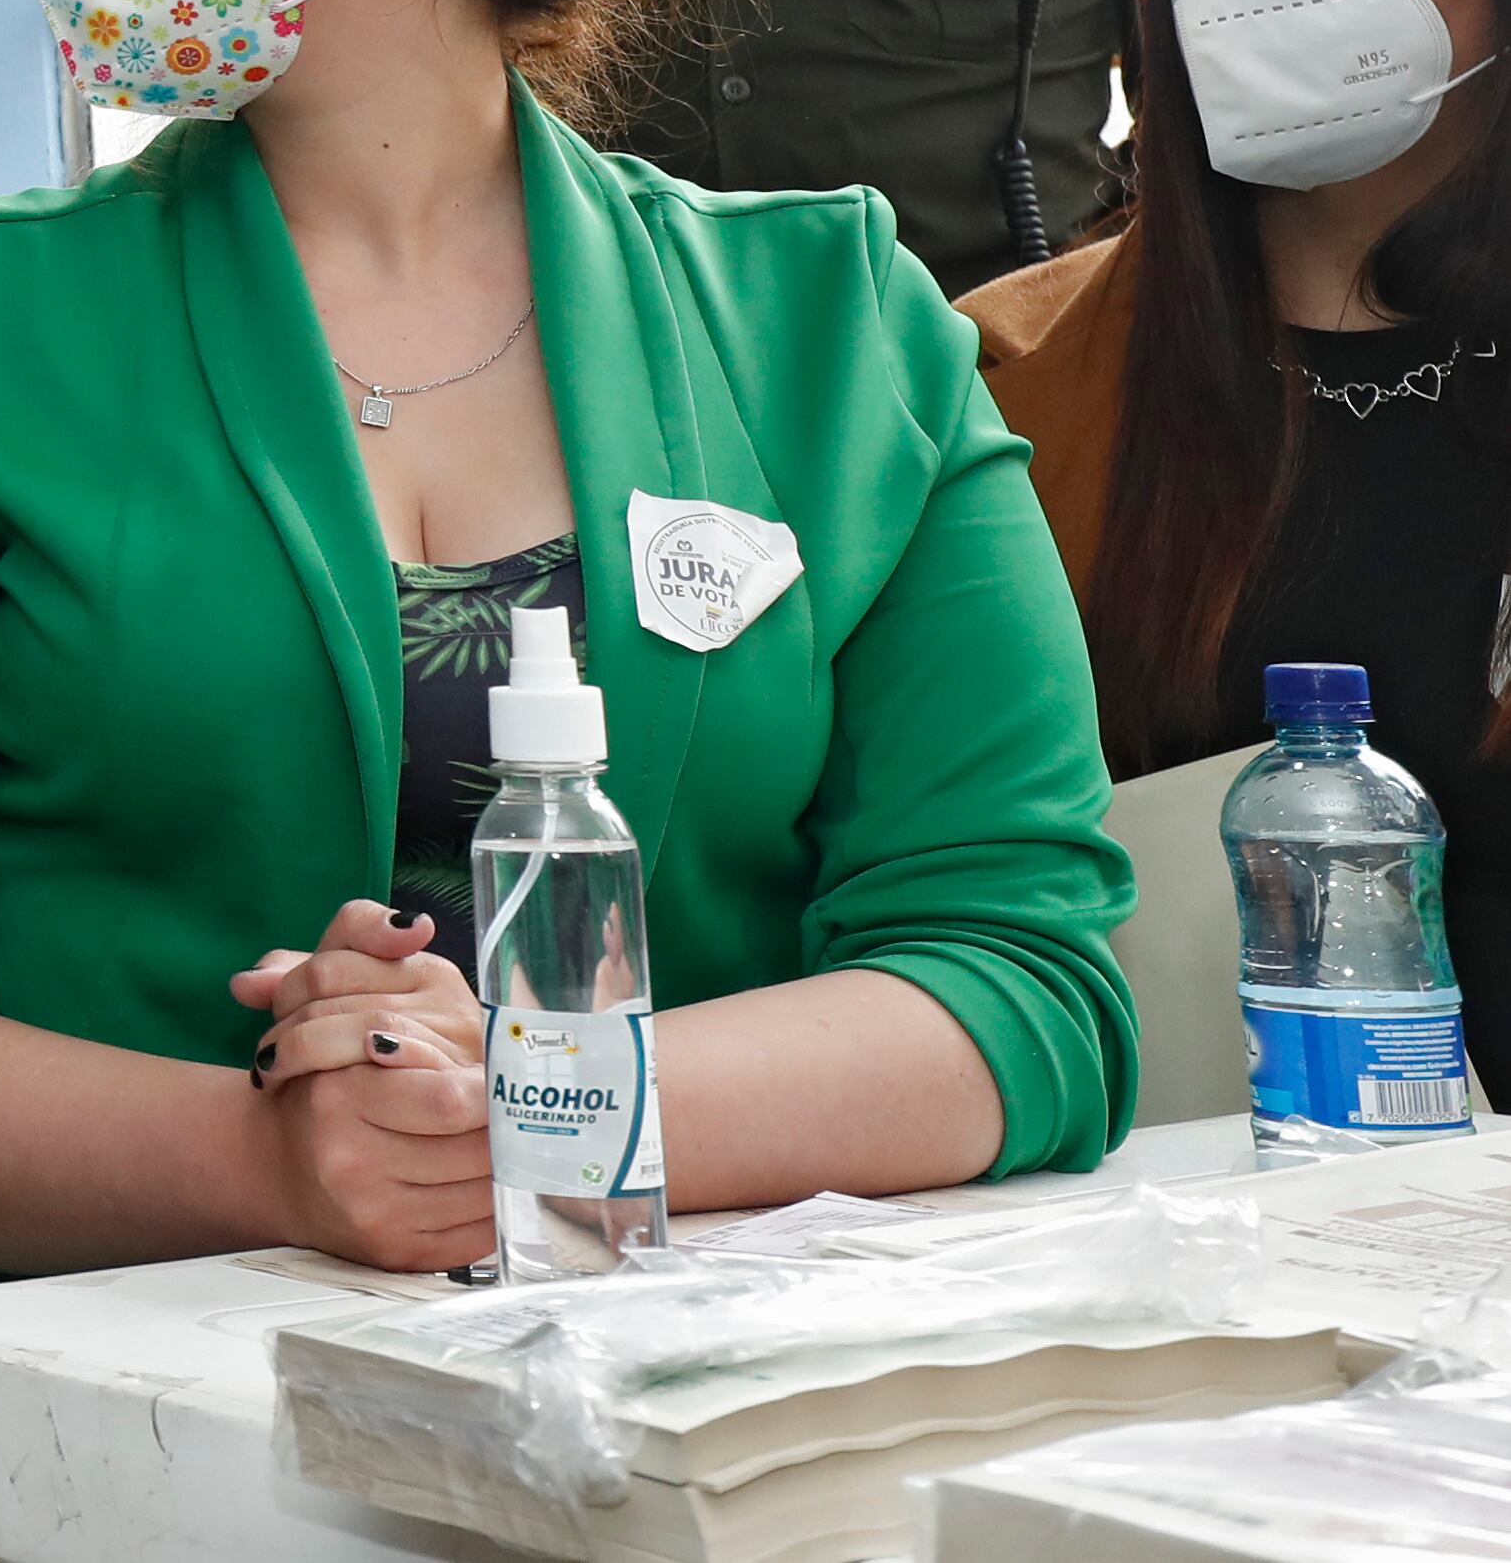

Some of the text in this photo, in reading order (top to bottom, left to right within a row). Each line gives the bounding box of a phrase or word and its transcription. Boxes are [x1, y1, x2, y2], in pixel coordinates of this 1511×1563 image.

[1357, 49, 1390, 69] N95
[659, 558, 742, 591] JURA
[660, 583, 686, 598] DE
[492, 1074, 619, 1111] ALCOHOL
[505, 1107, 597, 1124] GLICERINADO
